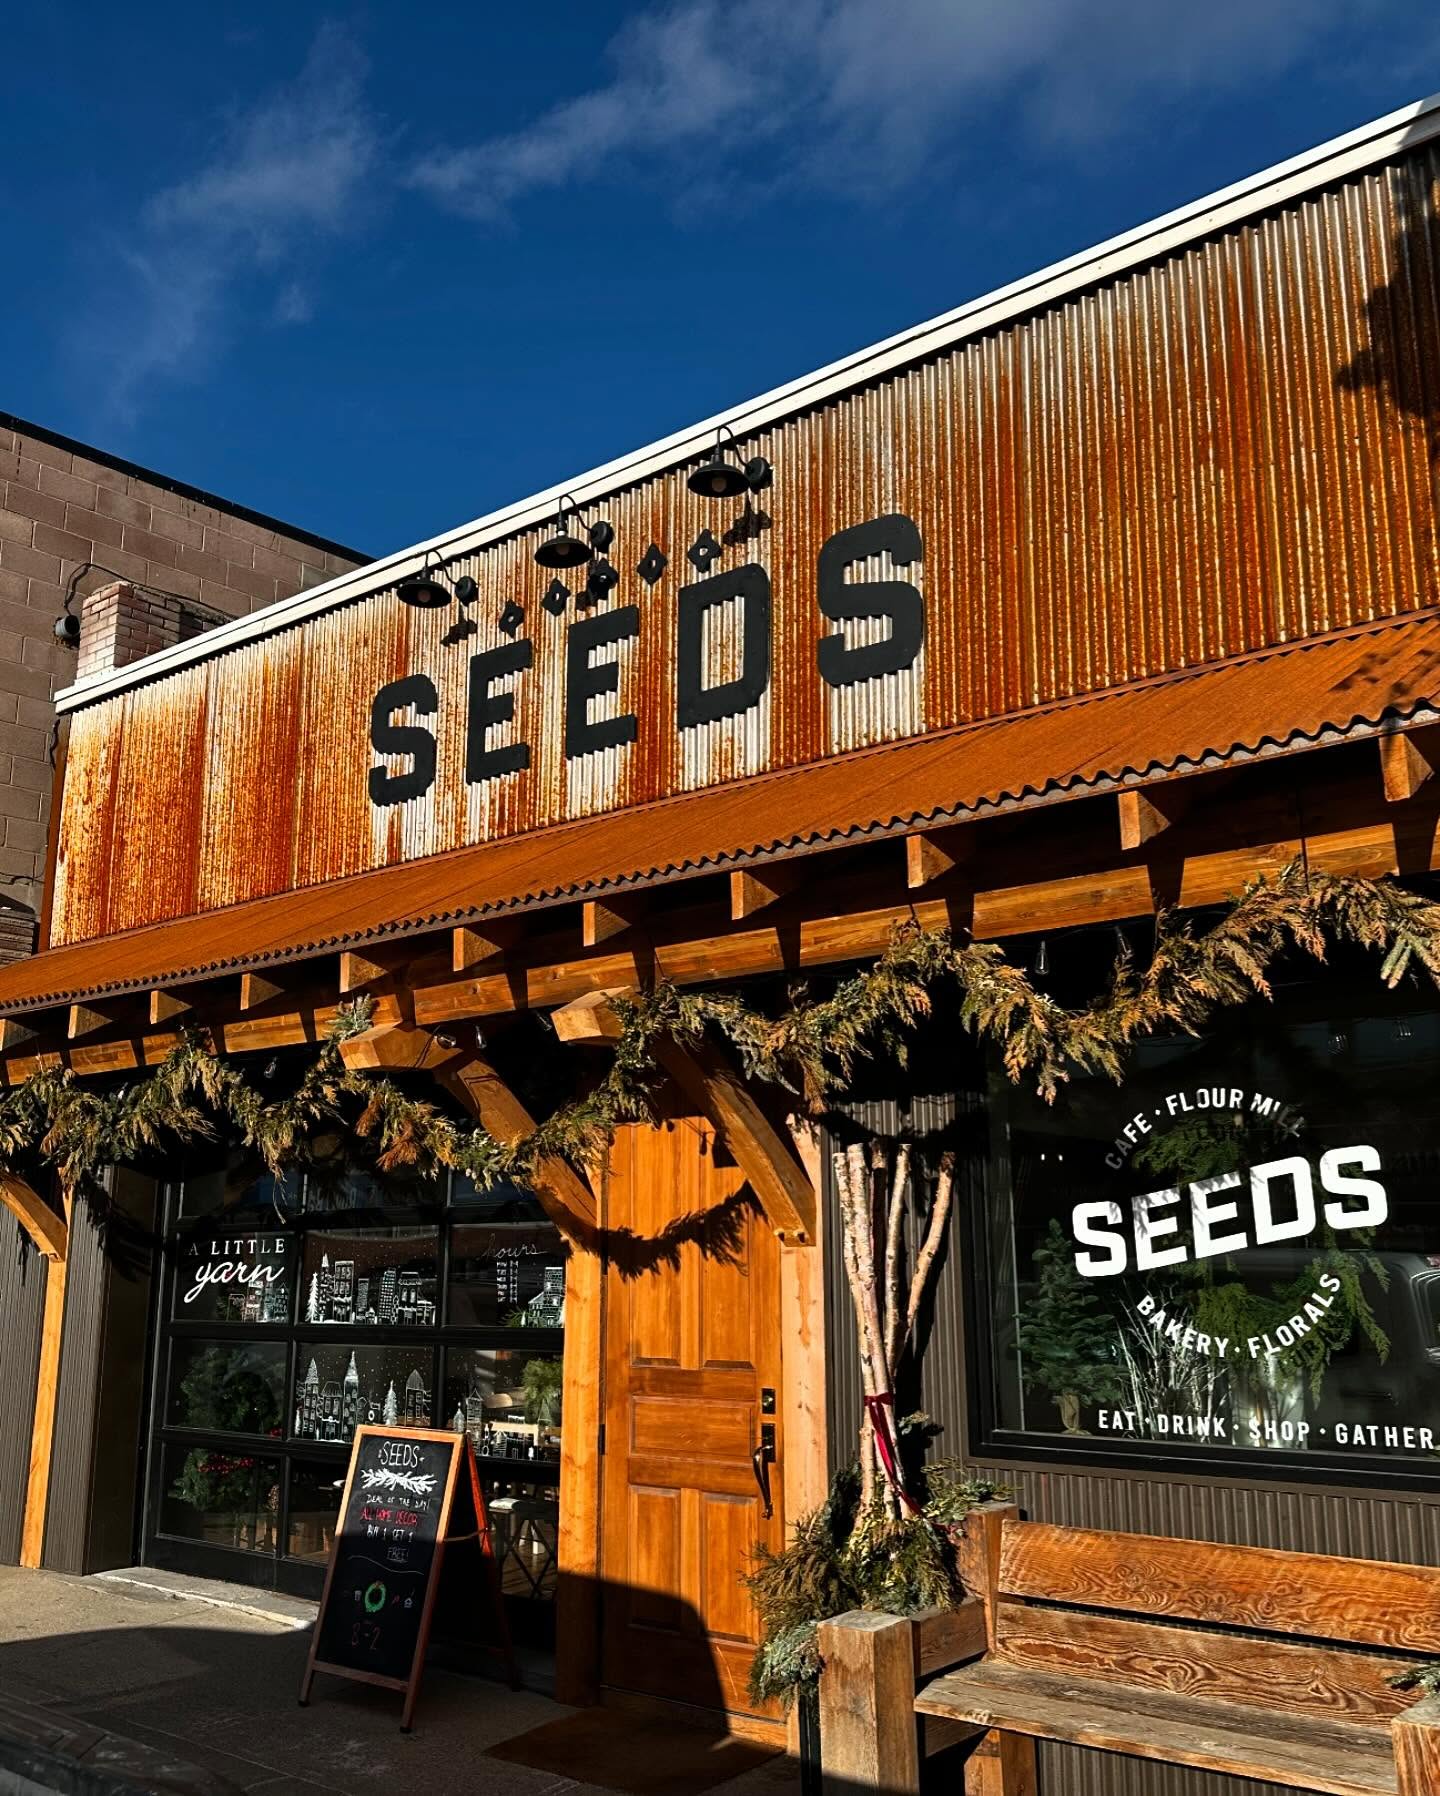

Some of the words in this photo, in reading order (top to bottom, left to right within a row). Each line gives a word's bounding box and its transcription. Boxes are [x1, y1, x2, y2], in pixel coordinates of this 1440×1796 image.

[368, 512, 924, 807] SEEDS
[1104, 1112, 1153, 1170] CAFE
[1165, 1087, 1245, 1116] FLOUR
[1072, 1145, 1389, 1278] SEEDS
[188, 1242, 200, 1256] A
[210, 1238, 285, 1255] LITTLE
[183, 1261, 285, 1304] yarn
[1136, 1295, 1229, 1359] BAKERY
[1247, 1273, 1341, 1359] FLORALS
[380, 1441, 420, 1468] SEEDS
[1098, 1409, 1136, 1432] EAT
[1157, 1414, 1227, 1438] DRINK
[1248, 1416, 1310, 1442] SHOP
[1334, 1423, 1434, 1450] GATHER
